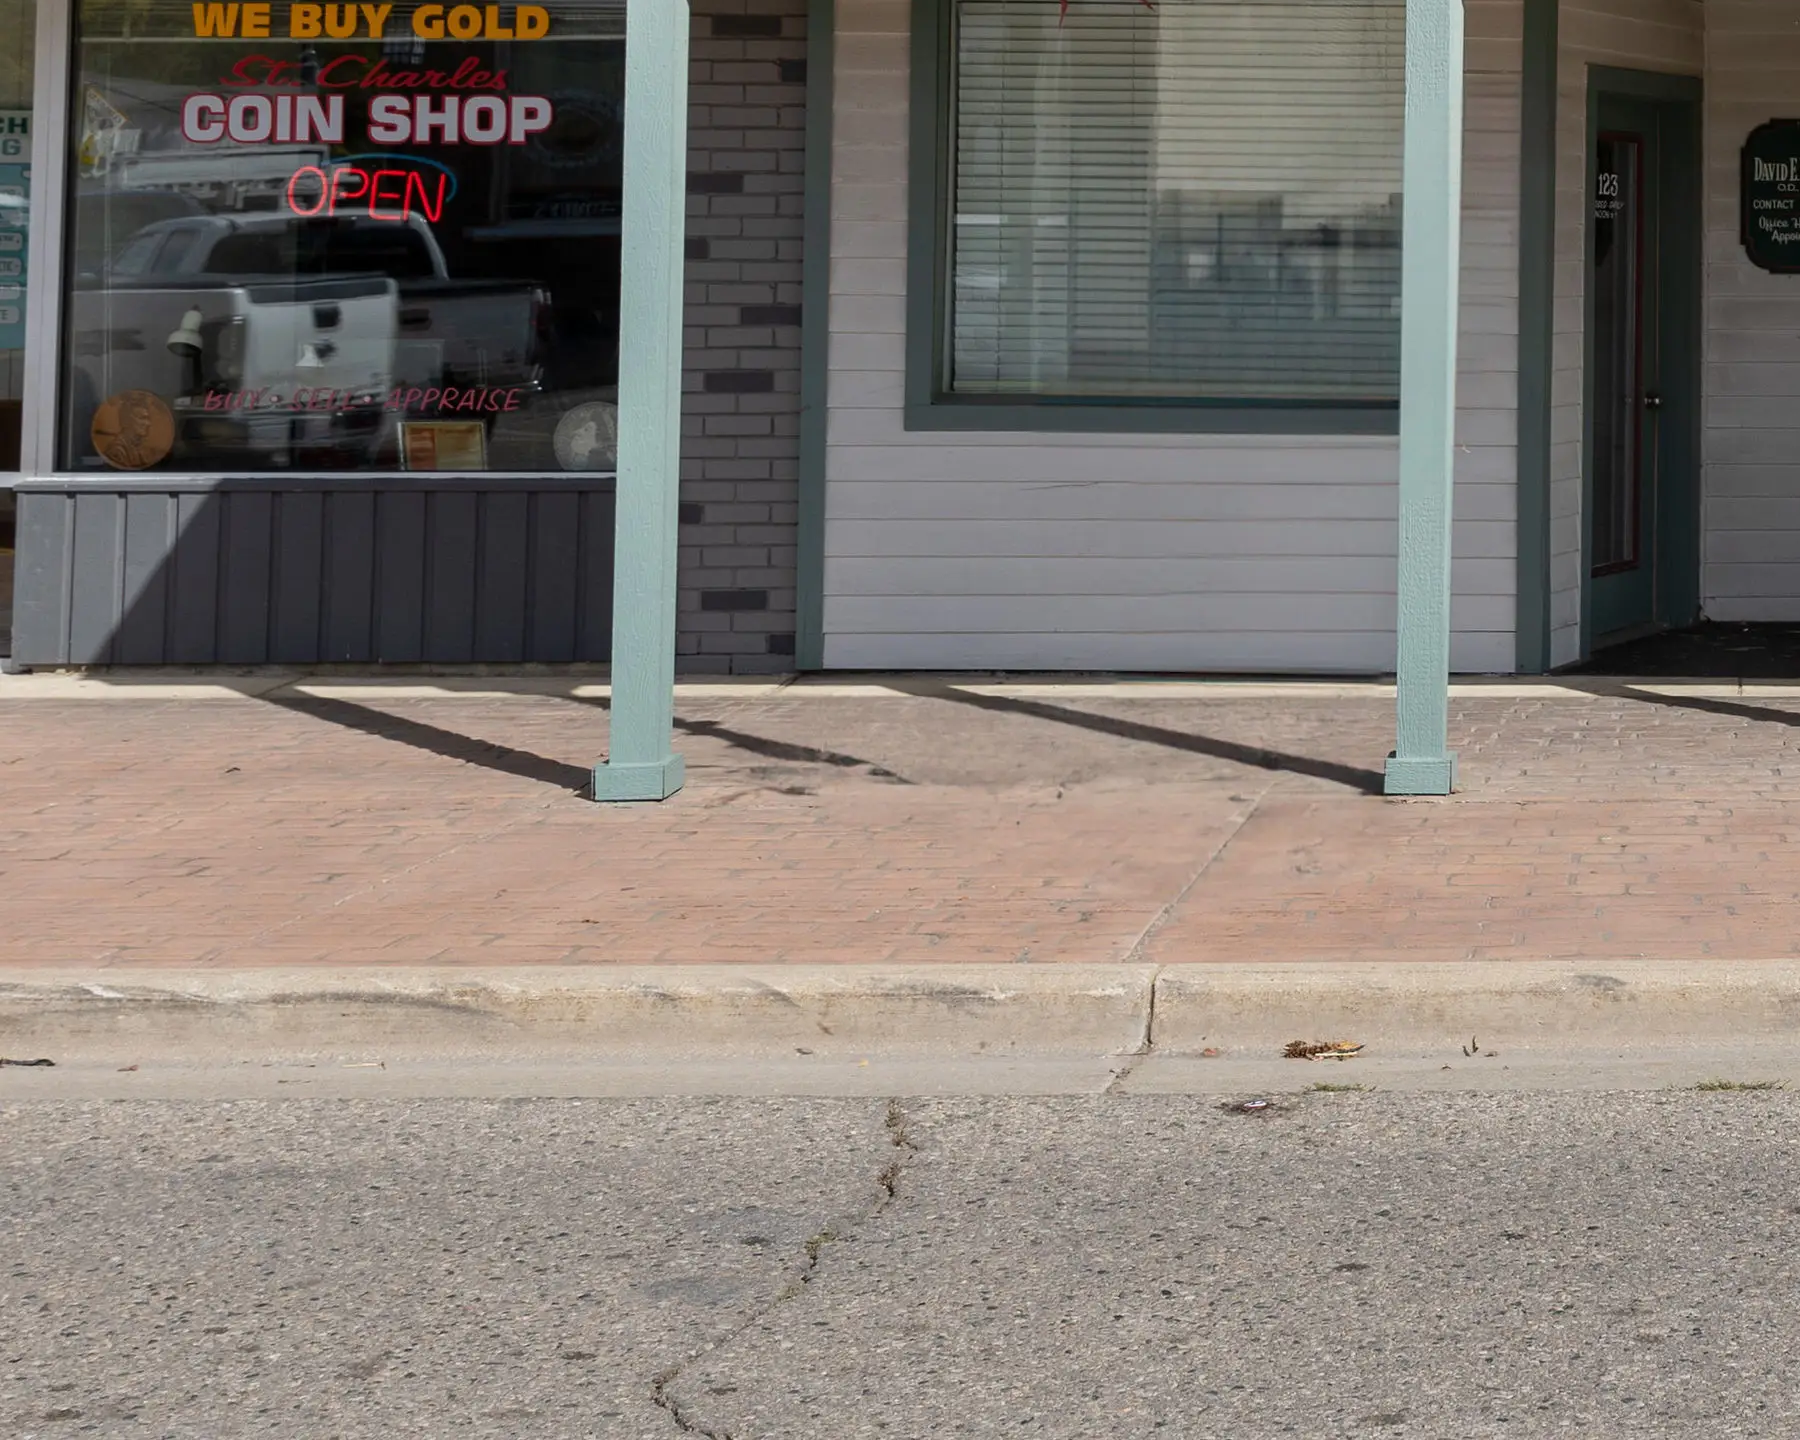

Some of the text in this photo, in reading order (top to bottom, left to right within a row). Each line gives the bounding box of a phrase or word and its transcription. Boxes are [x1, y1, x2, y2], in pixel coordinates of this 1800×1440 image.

[192, 3, 550, 40] WE BUY GOLD
[219, 54, 508, 90] St. Charles
[181, 93, 344, 144] COIN
[367, 94, 553, 145] SHOP
[1754, 157, 1788, 182] DAVID
[288, 165, 446, 223] OPEN
[1598, 172, 1619, 197] 123
[1753, 199, 1794, 210] CONTACT
[1758, 215, 1790, 232] Office
[203, 389, 522, 411] BUY SELL APPRAISE
